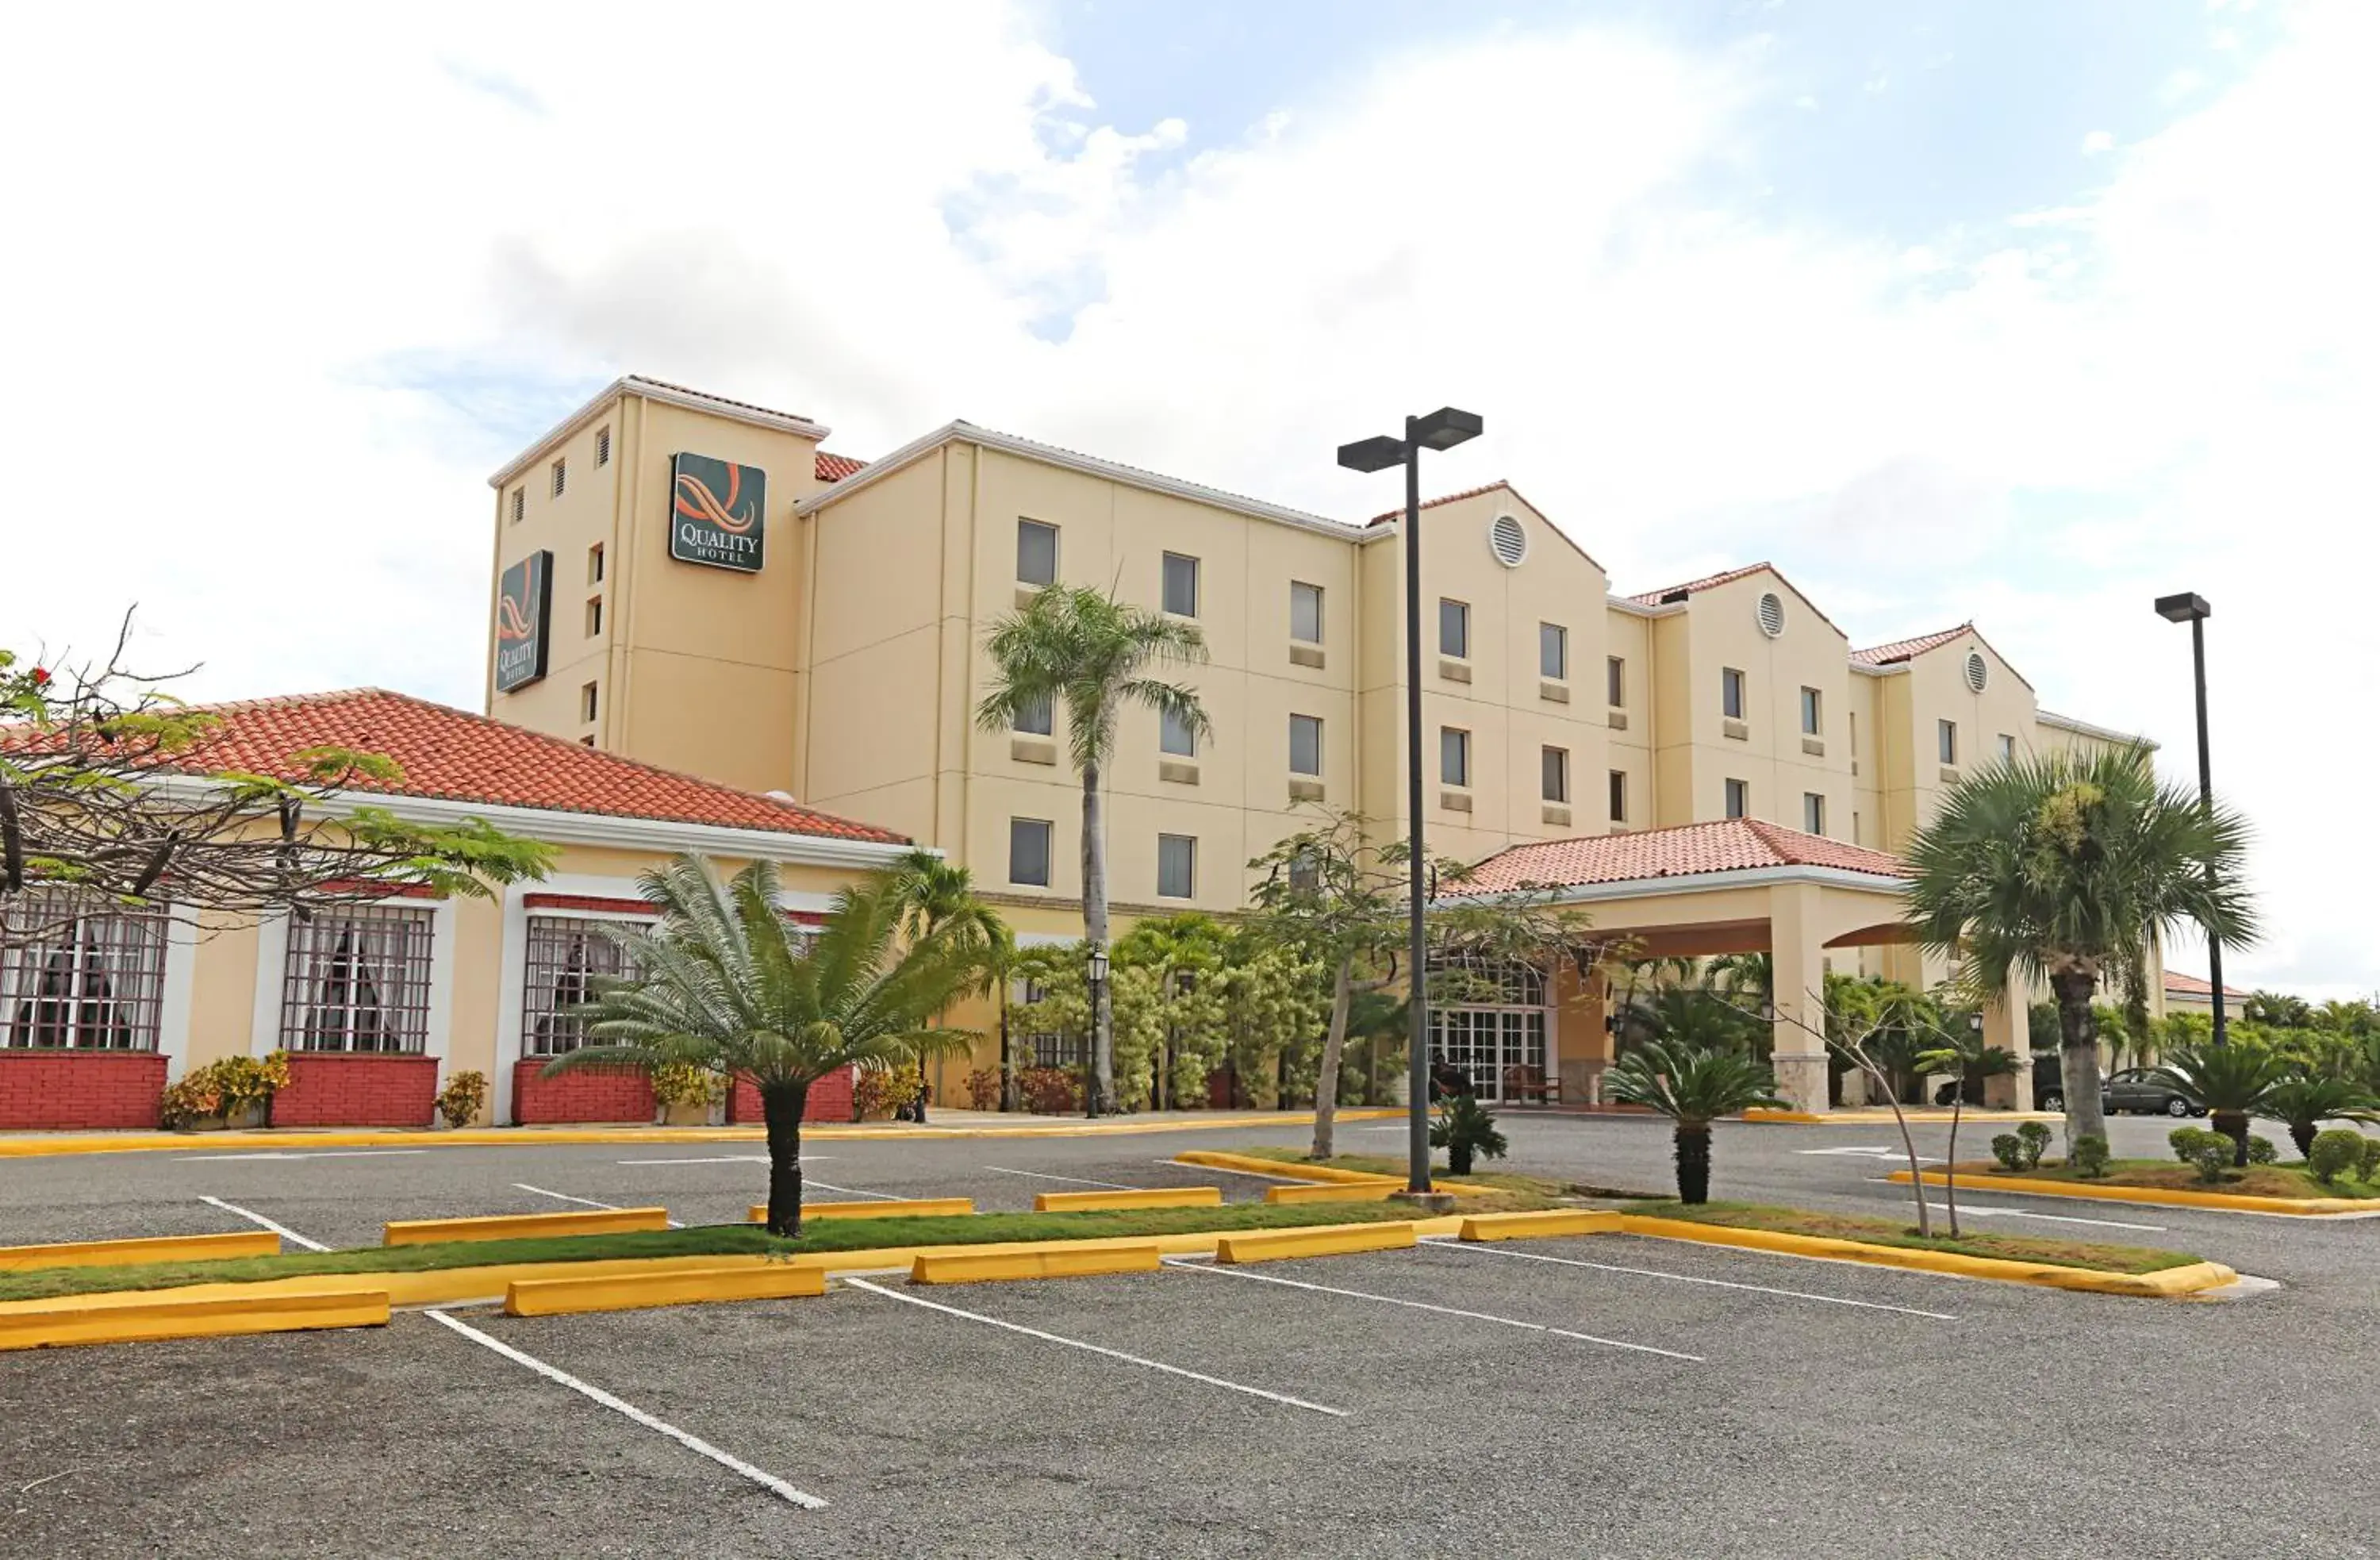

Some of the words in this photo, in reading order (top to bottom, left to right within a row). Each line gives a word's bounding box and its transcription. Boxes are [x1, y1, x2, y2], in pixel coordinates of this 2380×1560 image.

[681, 523, 758, 553] QUALITY
[697, 547, 745, 563] HOTEL
[500, 640, 533, 672] QUALITY
